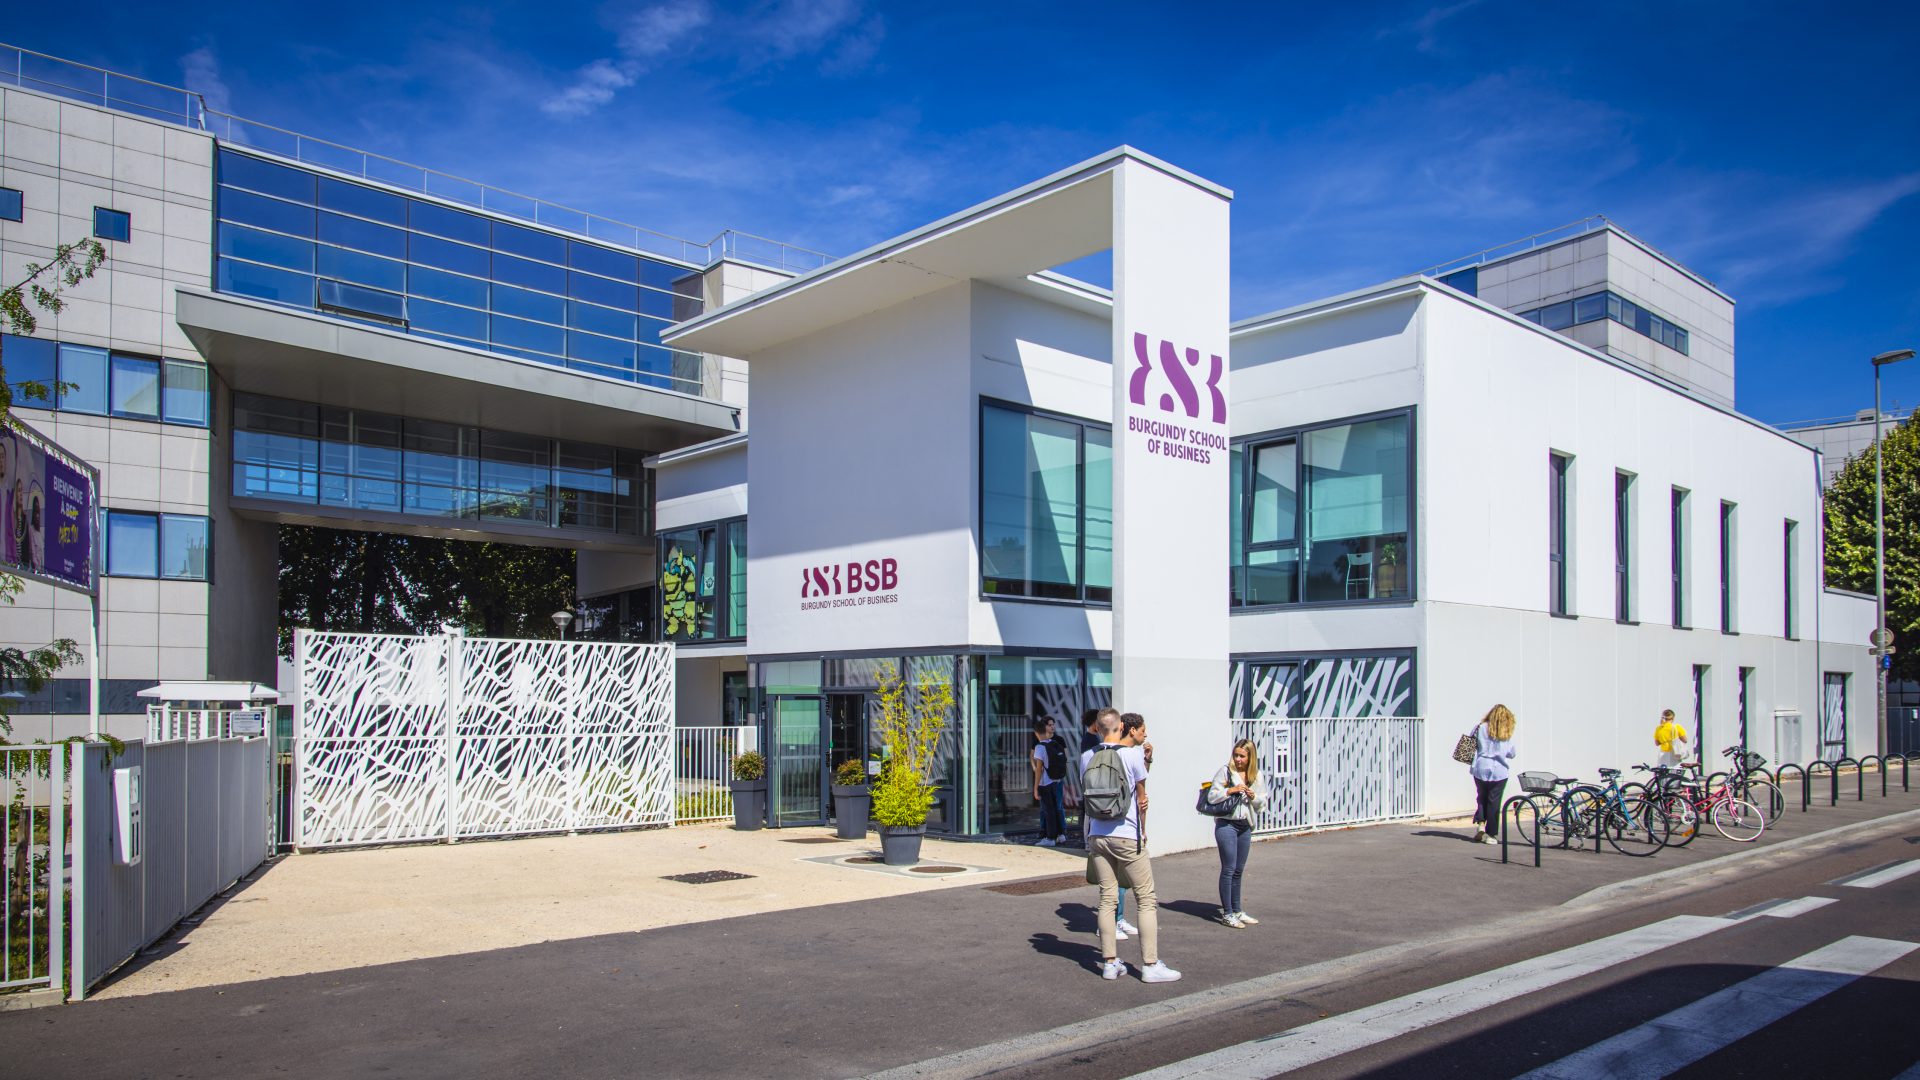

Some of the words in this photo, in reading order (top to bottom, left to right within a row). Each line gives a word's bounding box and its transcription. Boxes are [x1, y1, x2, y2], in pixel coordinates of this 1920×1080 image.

[1129, 416, 1186, 442] BURGUNDY
[1189, 430, 1227, 450] SCHOOL
[1147, 438, 1161, 454] OF
[1163, 443, 1211, 464] BUSINESS
[53, 475, 84, 505] BIENVENUE
[847, 558, 898, 594] BSB
[801, 600, 832, 611] BURGUNDY
[832, 598, 857, 608] SCHOOL
[857, 597, 866, 605] OF
[867, 594, 898, 605] BUSINESS
